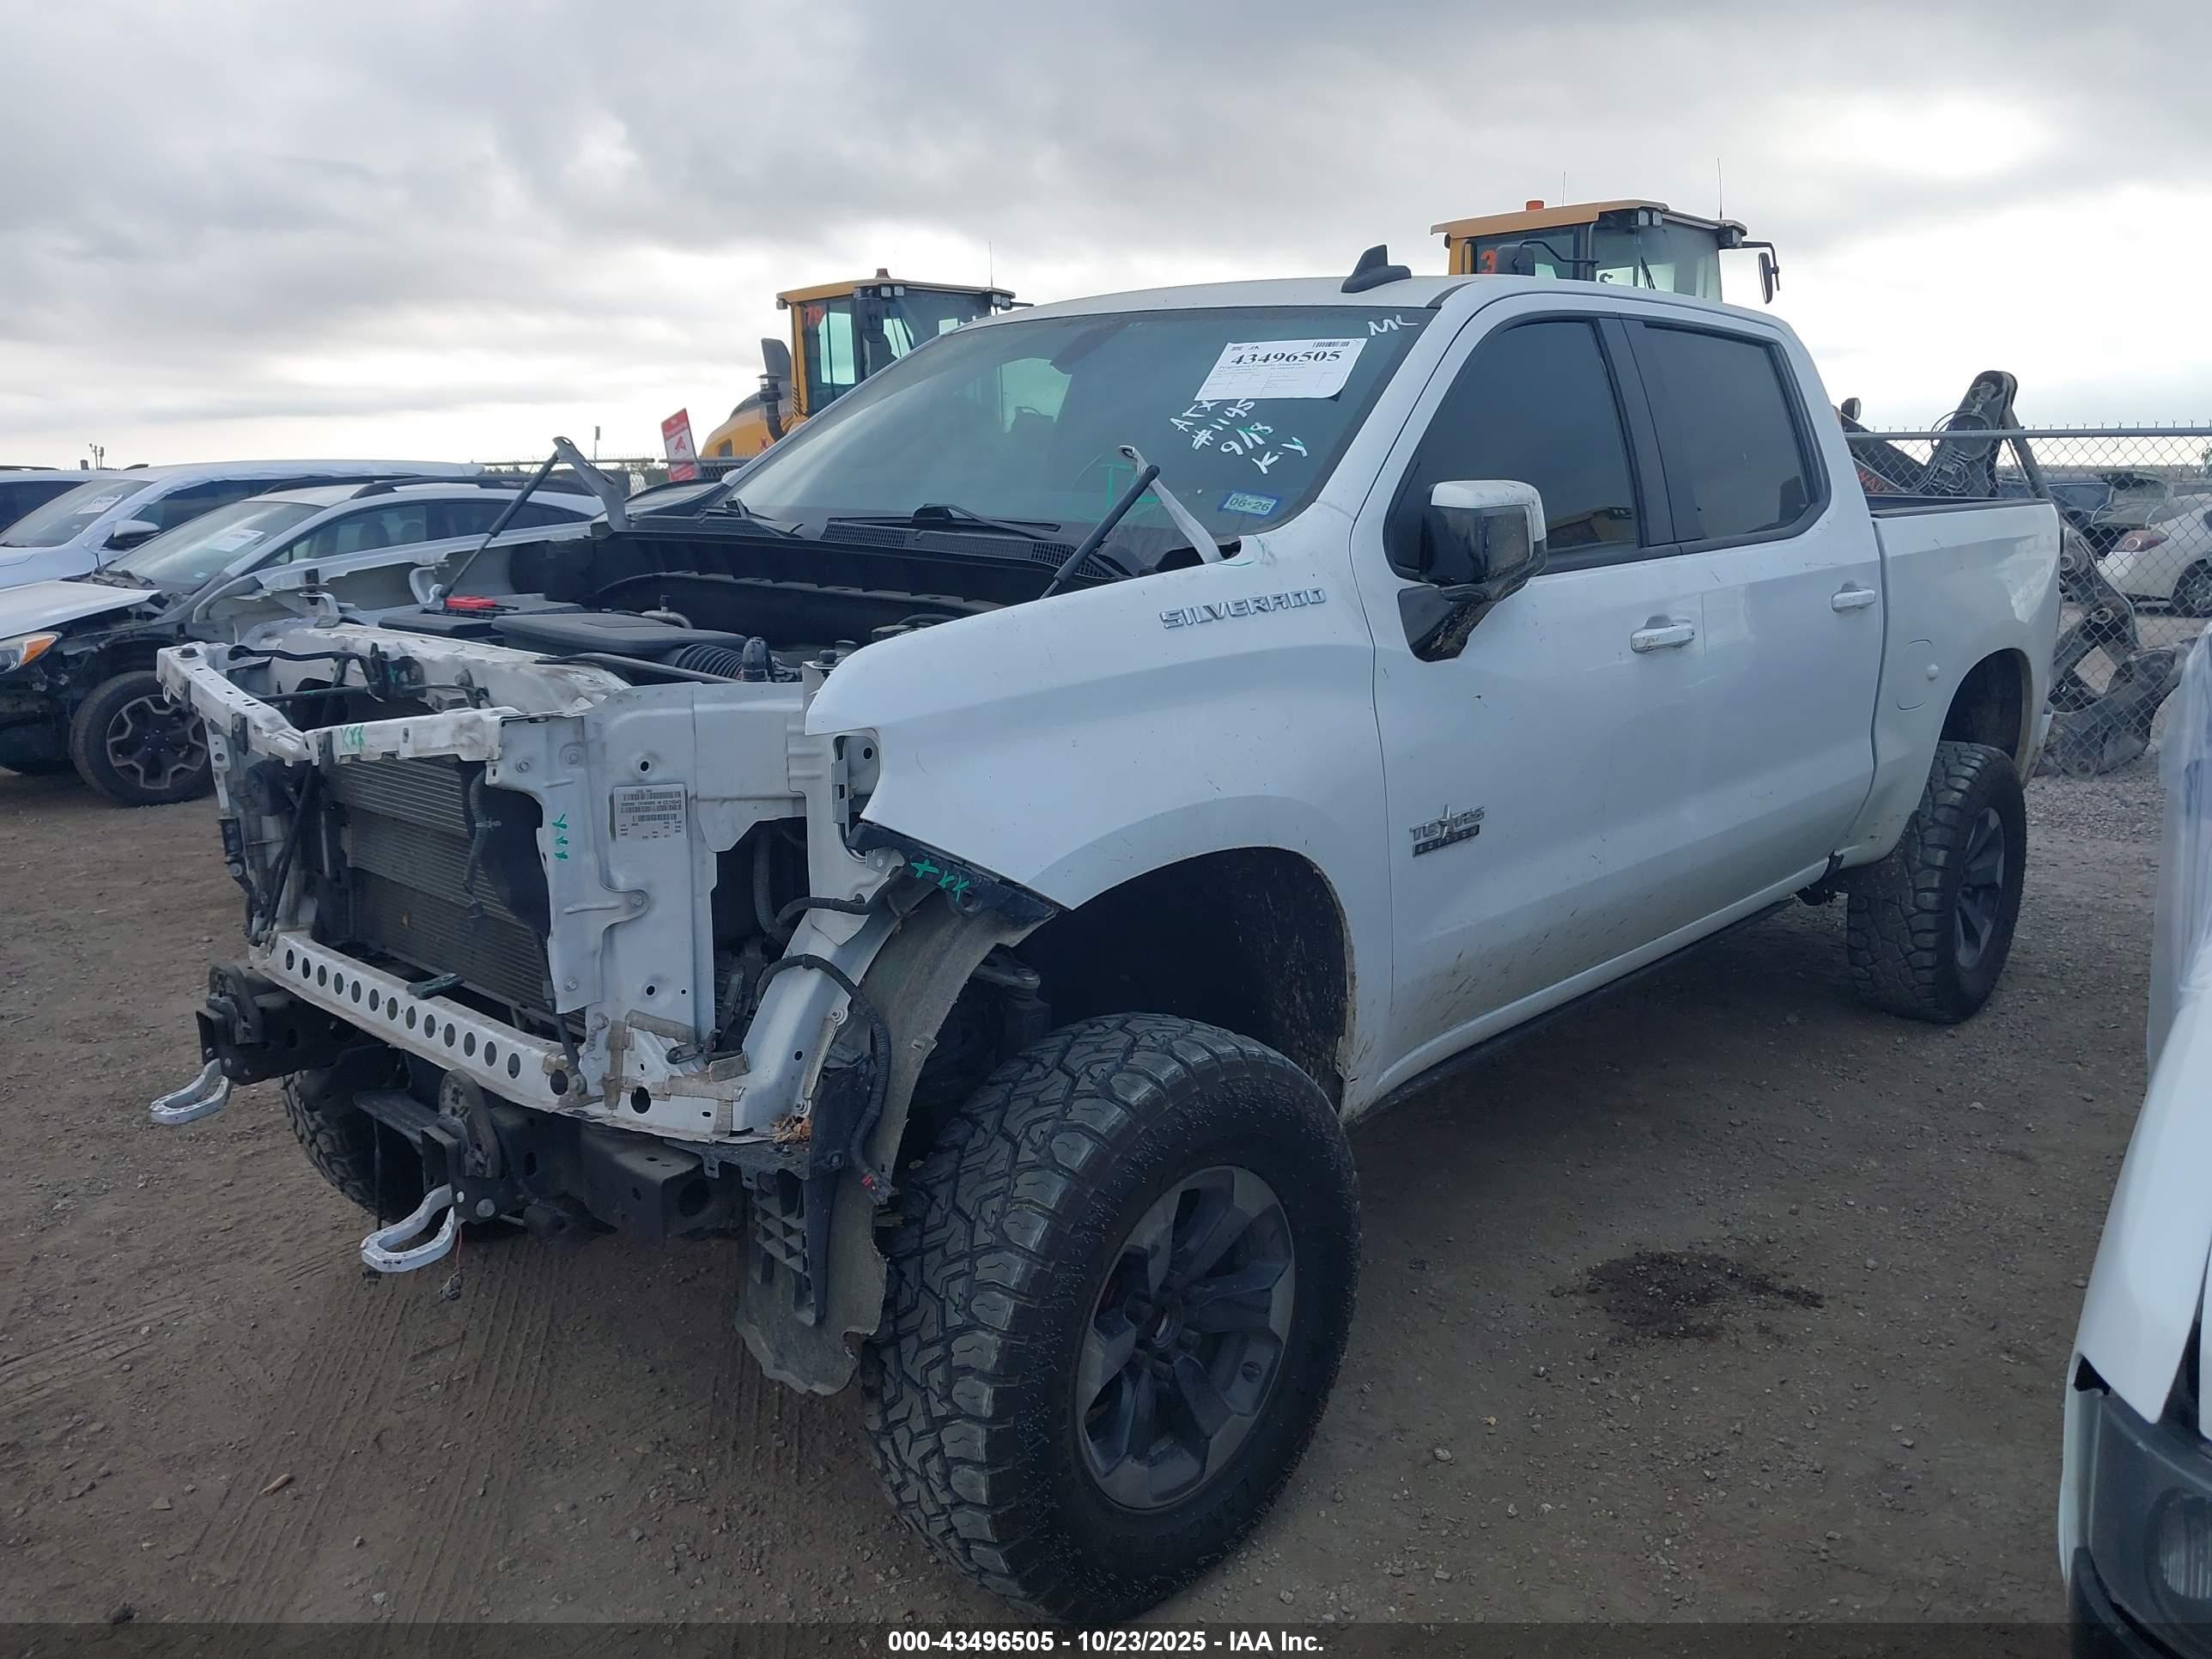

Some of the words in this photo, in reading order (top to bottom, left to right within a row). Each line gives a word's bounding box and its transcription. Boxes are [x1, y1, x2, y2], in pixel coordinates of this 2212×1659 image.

[1230, 349, 1344, 365] 43496505
[1229, 498, 1248, 507] 06
[1250, 501, 1271, 511] 26
[1159, 587, 1327, 629] SILVERADO
